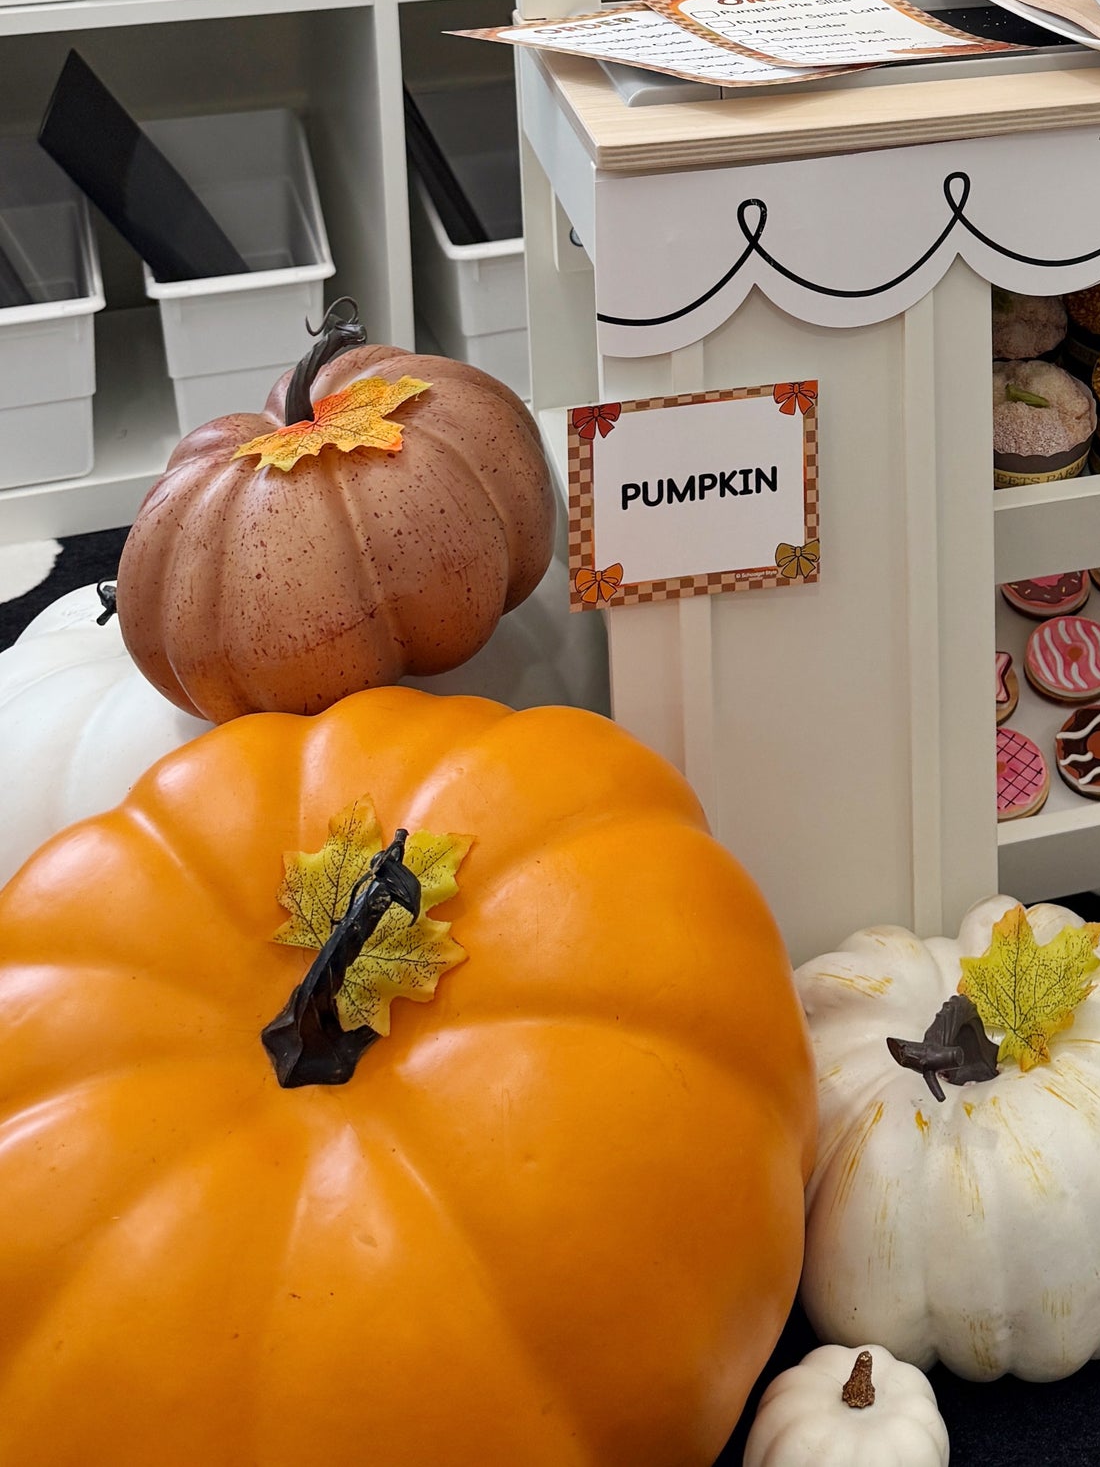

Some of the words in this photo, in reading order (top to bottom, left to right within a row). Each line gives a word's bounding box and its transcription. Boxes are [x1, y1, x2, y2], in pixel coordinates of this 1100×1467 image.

[720, 4, 786, 15] Pumpkin
[736, 15, 803, 26] Pumpkin
[805, 10, 848, 19] Spice
[850, 5, 891, 14] Latte
[533, 17, 639, 34] ORDER
[755, 26, 801, 34] Apple
[621, 465, 778, 511] PUMPKIN
